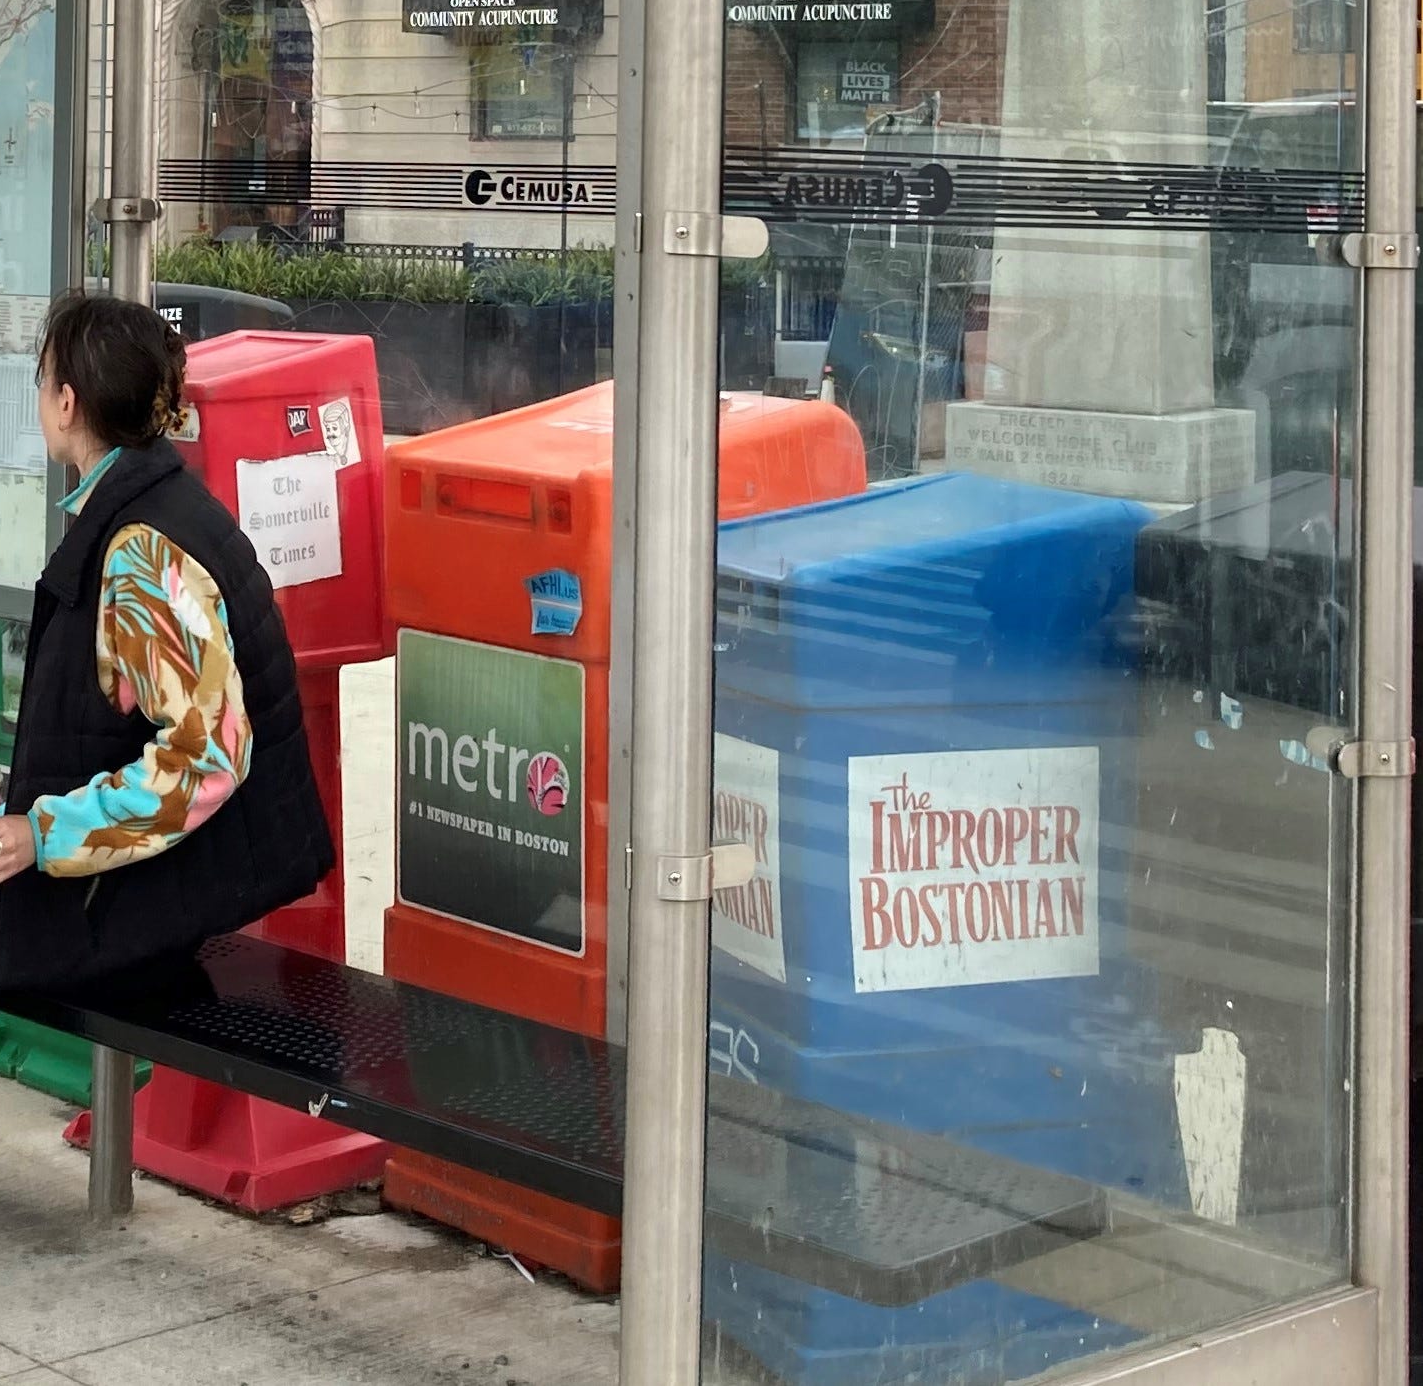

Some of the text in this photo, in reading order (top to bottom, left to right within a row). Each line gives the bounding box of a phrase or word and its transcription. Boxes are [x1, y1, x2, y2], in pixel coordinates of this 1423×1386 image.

[410, 9, 558, 27] COMMUNITY ACUPUNCTURE
[802, 3, 892, 21] ACUPUNCTURE
[845, 61, 886, 73] BLACK
[847, 75, 884, 87] LIVES
[501, 176, 589, 203] CEMUSA
[1000, 414, 1065, 430] ERECTED
[968, 429, 1157, 456] WELCOME HOME CLUB
[272, 475, 302, 496] The
[249, 502, 330, 530] Somerville
[270, 543, 316, 565] Times
[408, 720, 570, 816] metro
[881, 772, 932, 811] The
[409, 800, 570, 857] #1 NEWSPAPER IN BOSTON
[870, 801, 1081, 874] IMPROPER
[859, 877, 1086, 951] BOSTONIAN
